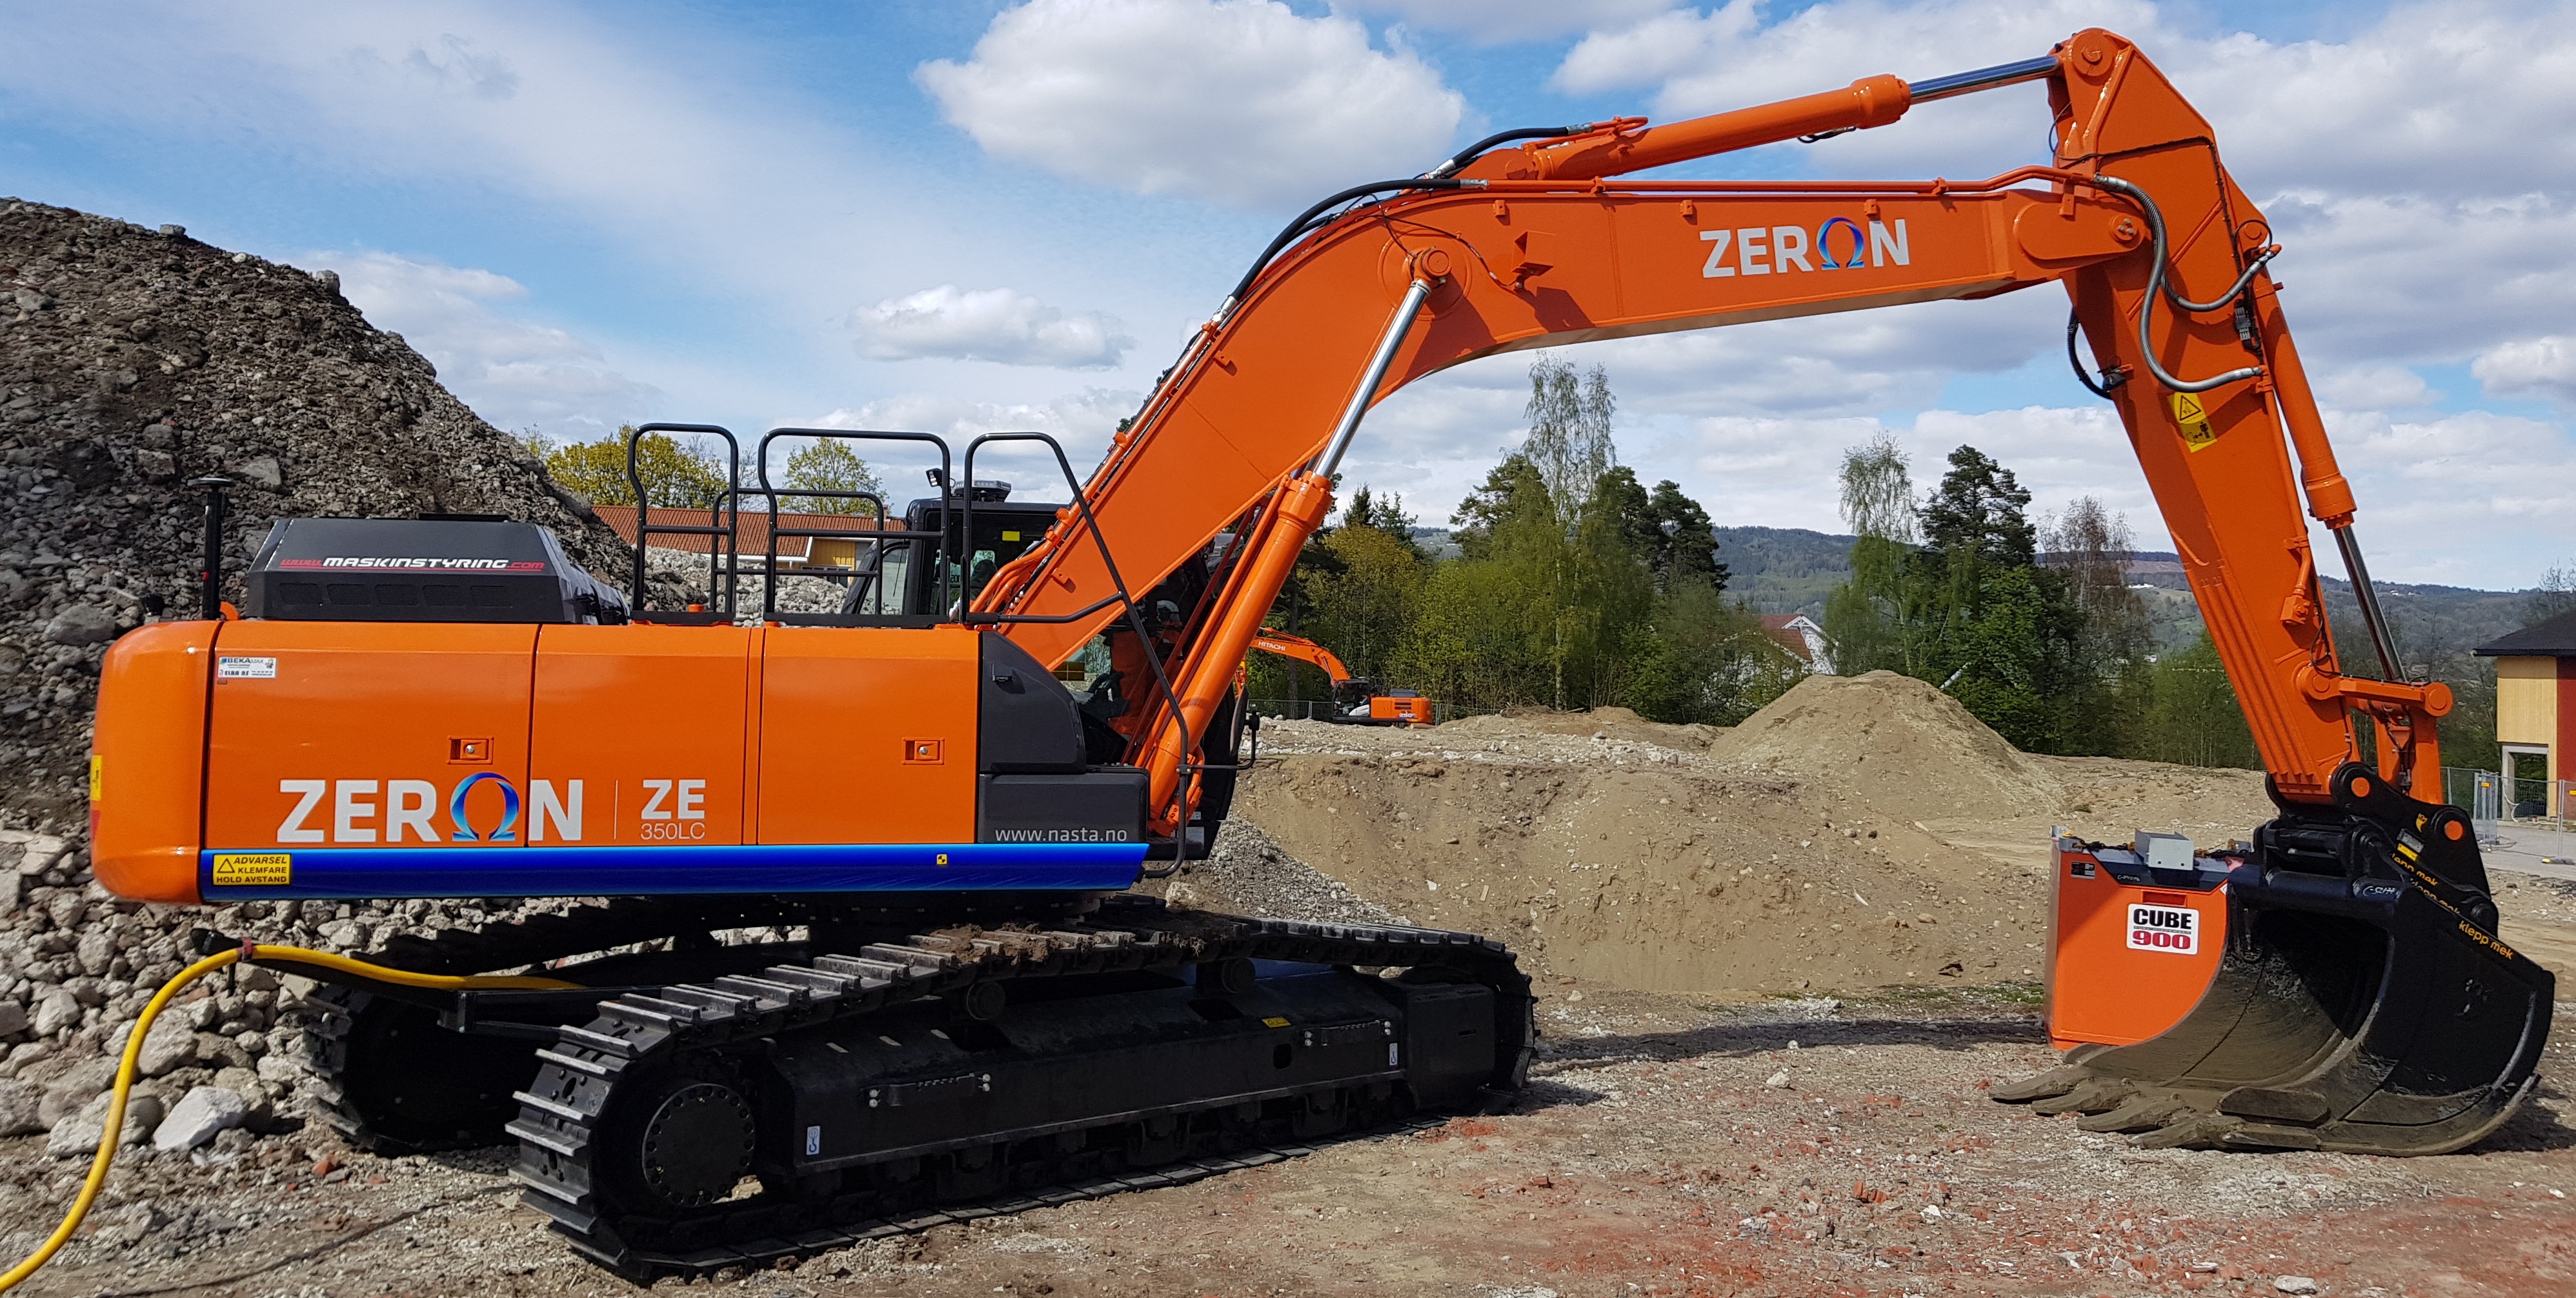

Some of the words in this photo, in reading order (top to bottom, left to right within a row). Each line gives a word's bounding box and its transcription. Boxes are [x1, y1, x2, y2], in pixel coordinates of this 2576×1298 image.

[1258, 641, 1285, 651] HITACHI
[641, 779, 706, 819] ZE
[640, 822, 705, 840] 350LC
[995, 827, 1127, 842] www.nasta.no
[2133, 908, 2192, 930] CUBE
[2132, 930, 2191, 950] 900
[2459, 921, 2489, 945] klepp
[2490, 941, 2514, 960] mek
